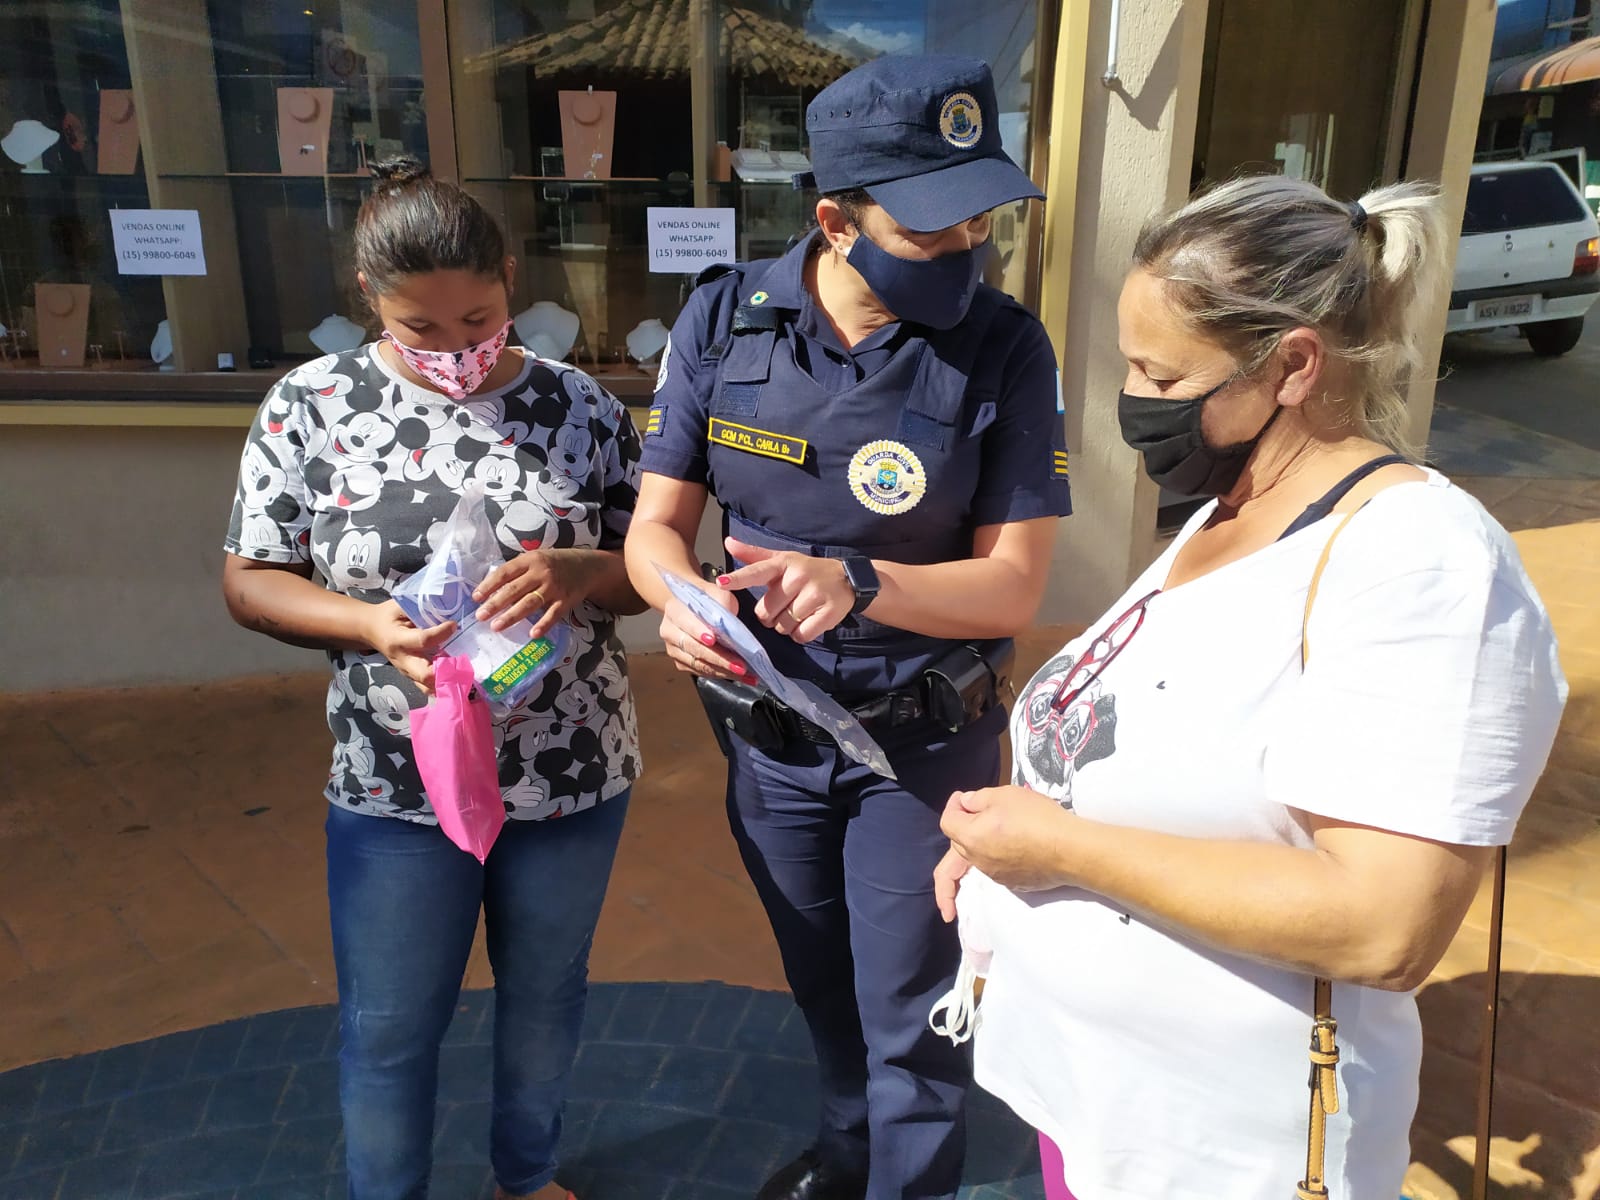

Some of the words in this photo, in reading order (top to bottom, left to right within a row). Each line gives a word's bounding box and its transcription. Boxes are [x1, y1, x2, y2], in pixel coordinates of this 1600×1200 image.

[121, 223, 154, 231] VENDAS
[155, 223, 185, 231] ONLINE
[657, 221, 690, 229] VENDAS
[691, 221, 721, 229] ONLINE
[122, 250, 141, 260] (15)
[142, 250, 196, 260] 99800-6049
[655, 248, 673, 258] (15)
[675, 248, 728, 258] 99800-6049
[721, 429, 737, 442] GCM
[756, 438, 780, 453] CARLA
[867, 451, 894, 465] GUARDA
[896, 454, 911, 471] CIVIL
[870, 492, 904, 504] MUNICIPAL
[521, 641, 539, 657] USAR
[516, 653, 524, 661] A
[525, 658, 534, 667] E
[502, 663, 529, 687] ACERTOS
